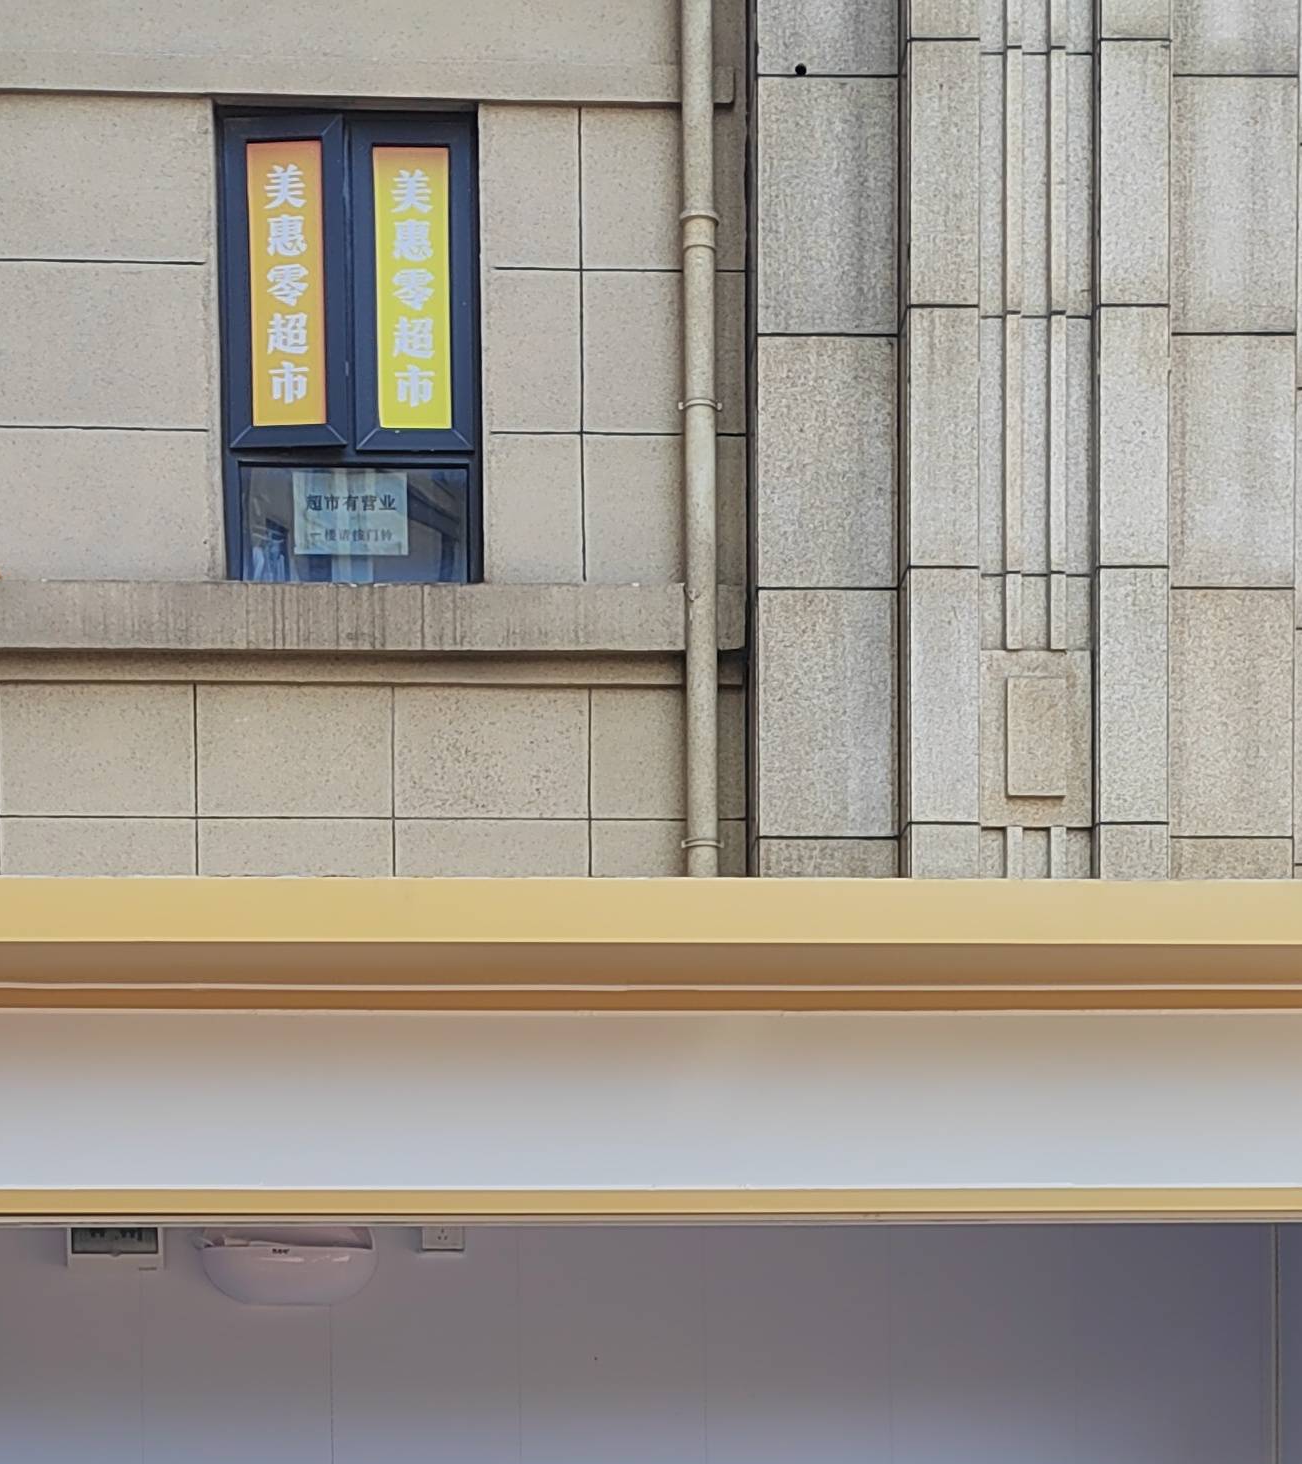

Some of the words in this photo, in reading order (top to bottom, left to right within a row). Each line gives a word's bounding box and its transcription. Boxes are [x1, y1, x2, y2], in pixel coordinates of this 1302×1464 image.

[263, 163, 309, 405] 美惠零超市
[391, 168, 436, 408] 美惠零超市
[306, 494, 397, 511] 超市有营业
